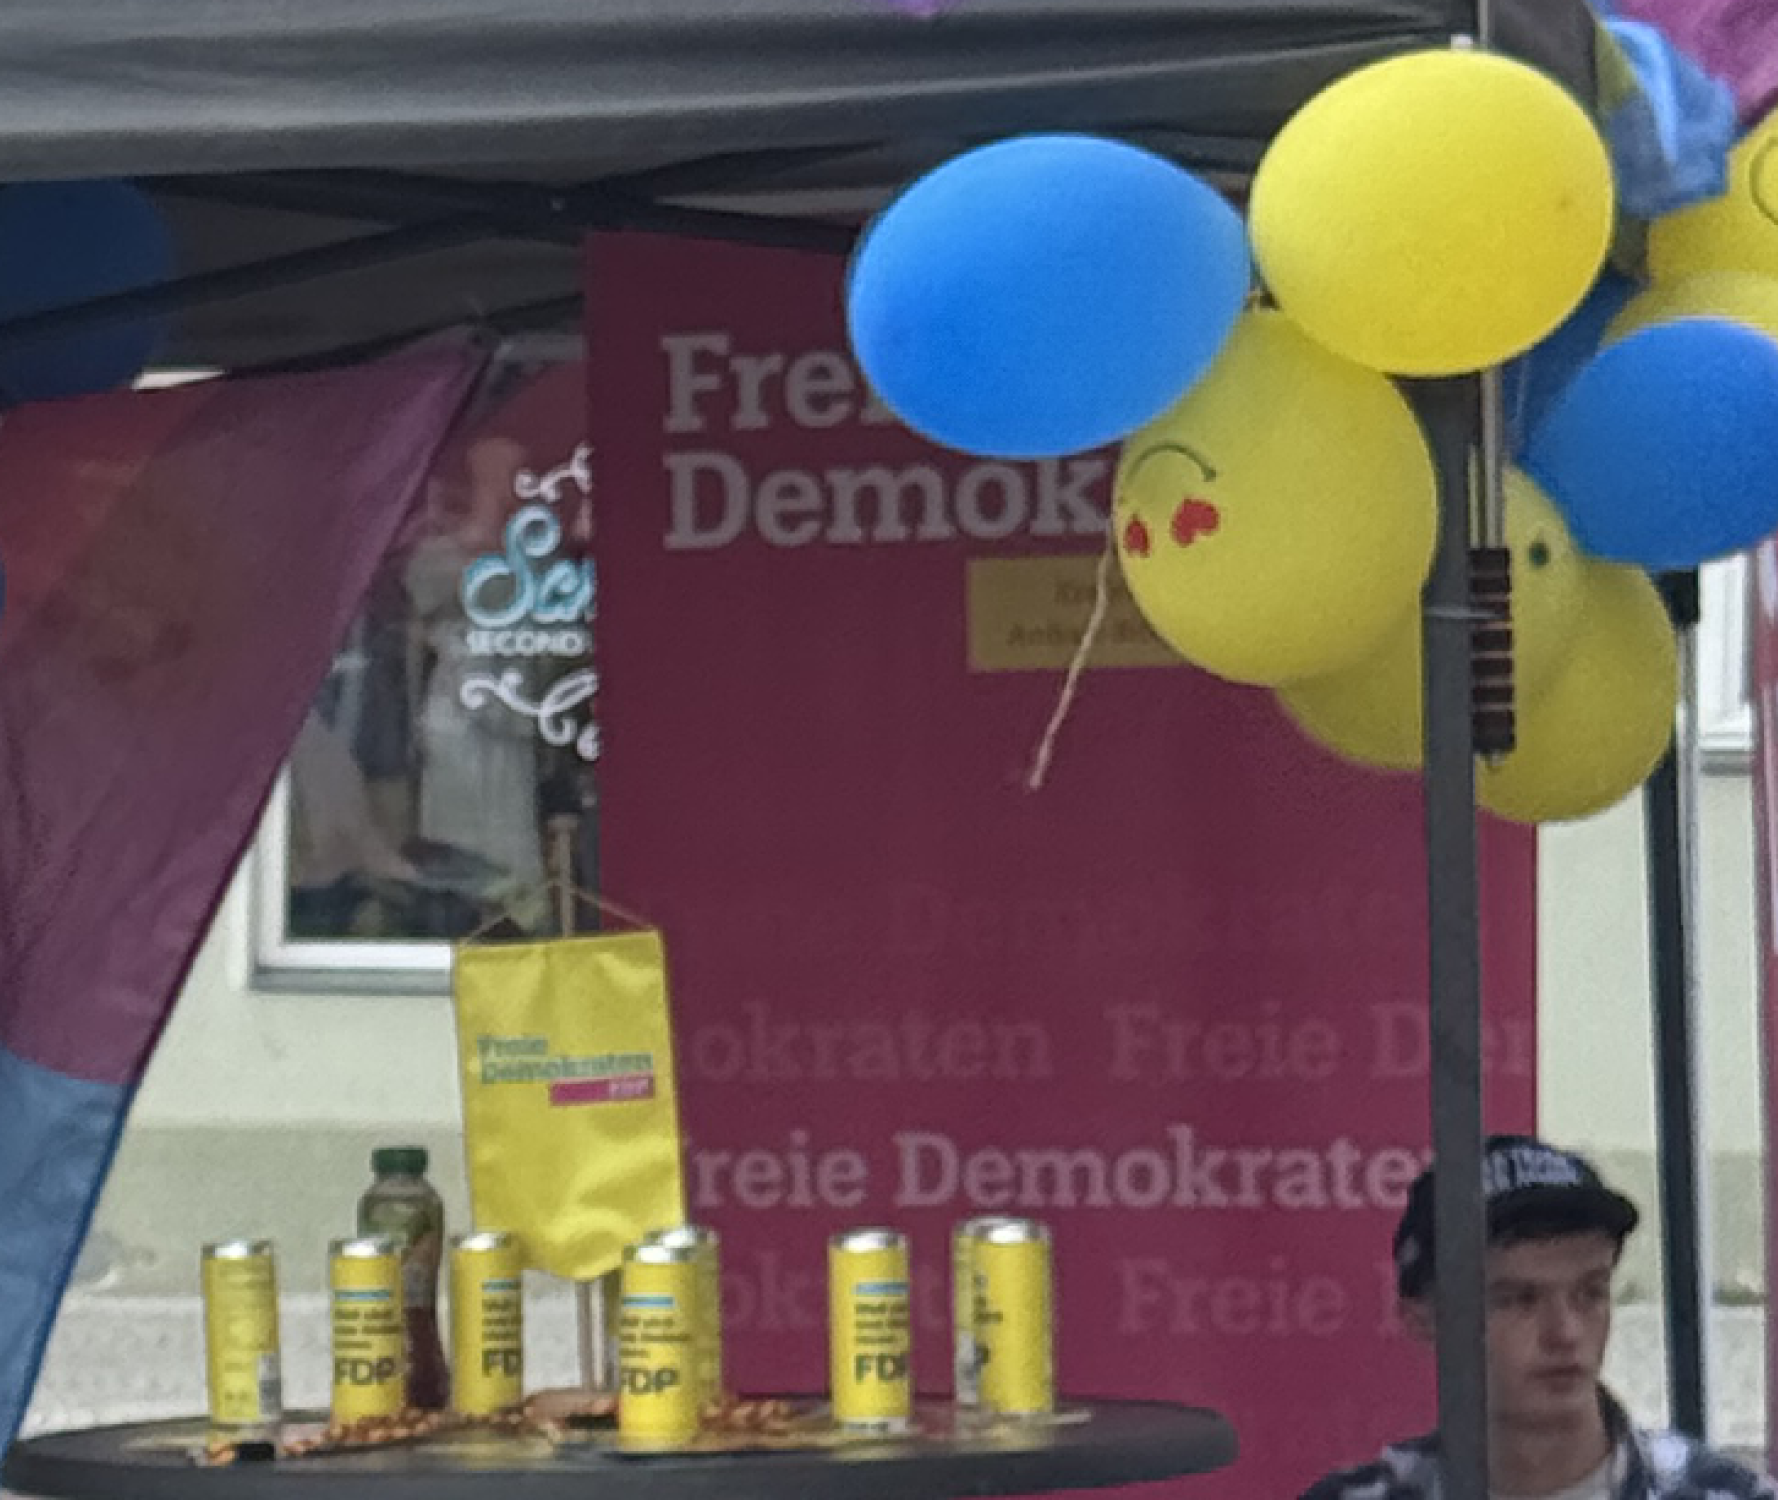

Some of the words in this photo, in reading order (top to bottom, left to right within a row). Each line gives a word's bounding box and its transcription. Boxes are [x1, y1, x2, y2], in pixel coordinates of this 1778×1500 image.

[1105, 1000, 1343, 1083] Freie
[684, 1130, 868, 1210] reie
[892, 1124, 1434, 1211] Demokrate
[333, 1357, 396, 1387] FDP
